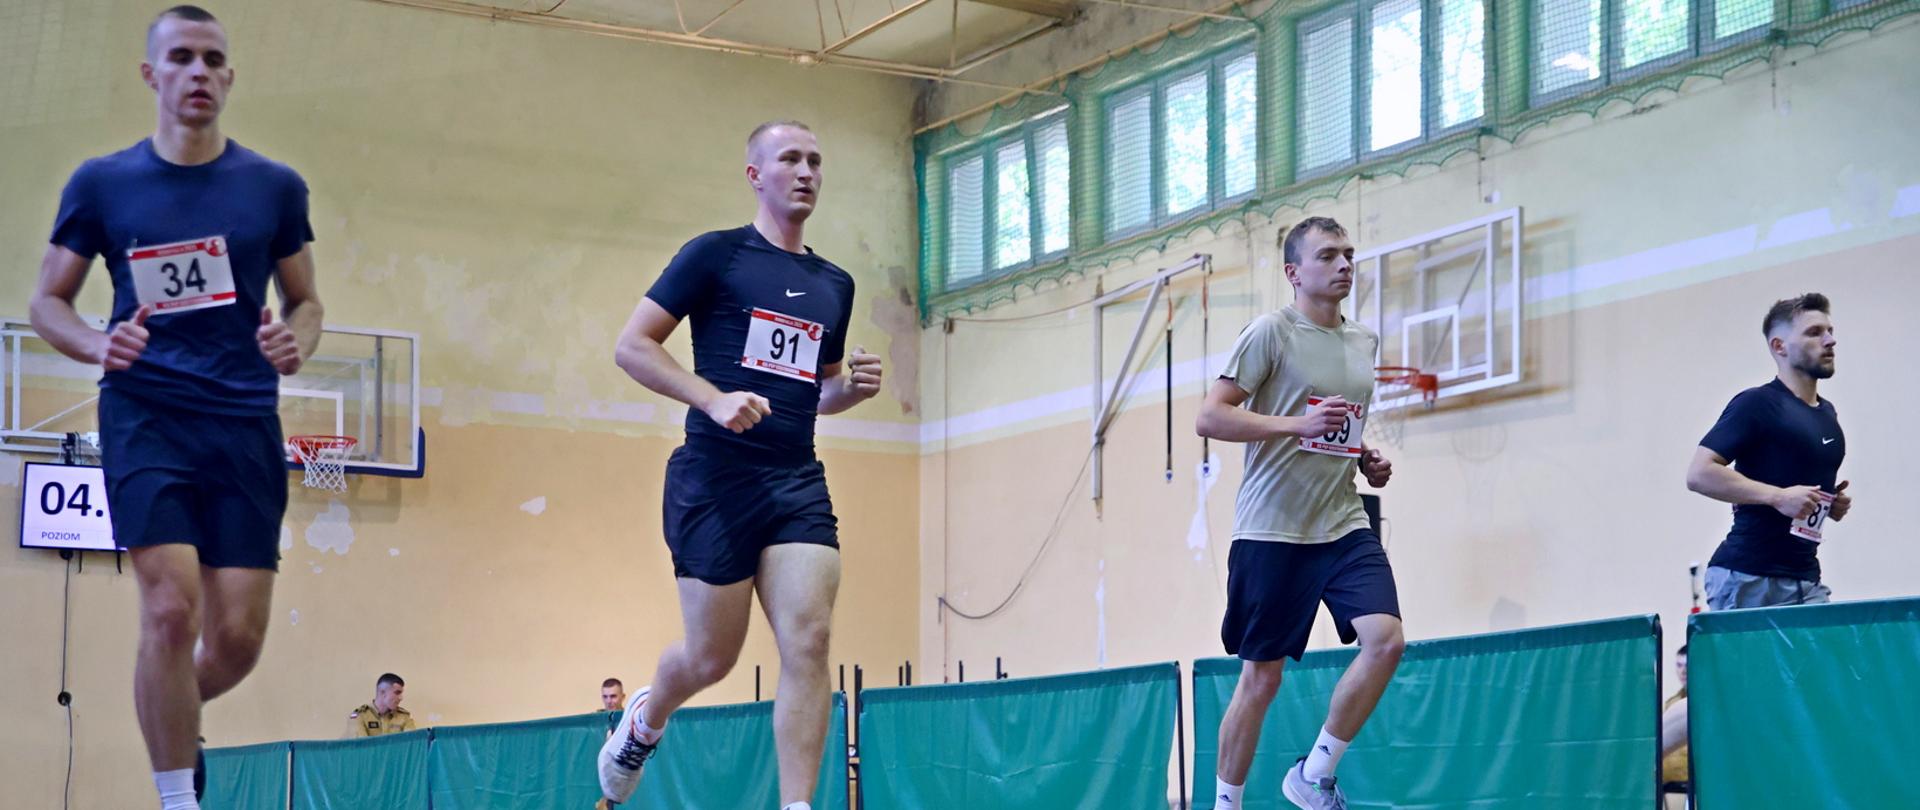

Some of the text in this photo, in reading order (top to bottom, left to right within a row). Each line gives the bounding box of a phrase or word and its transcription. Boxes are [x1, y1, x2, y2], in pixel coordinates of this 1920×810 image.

[160, 257, 207, 298] 34
[770, 328, 800, 364] 91
[41, 531, 81, 541] POZIOM
